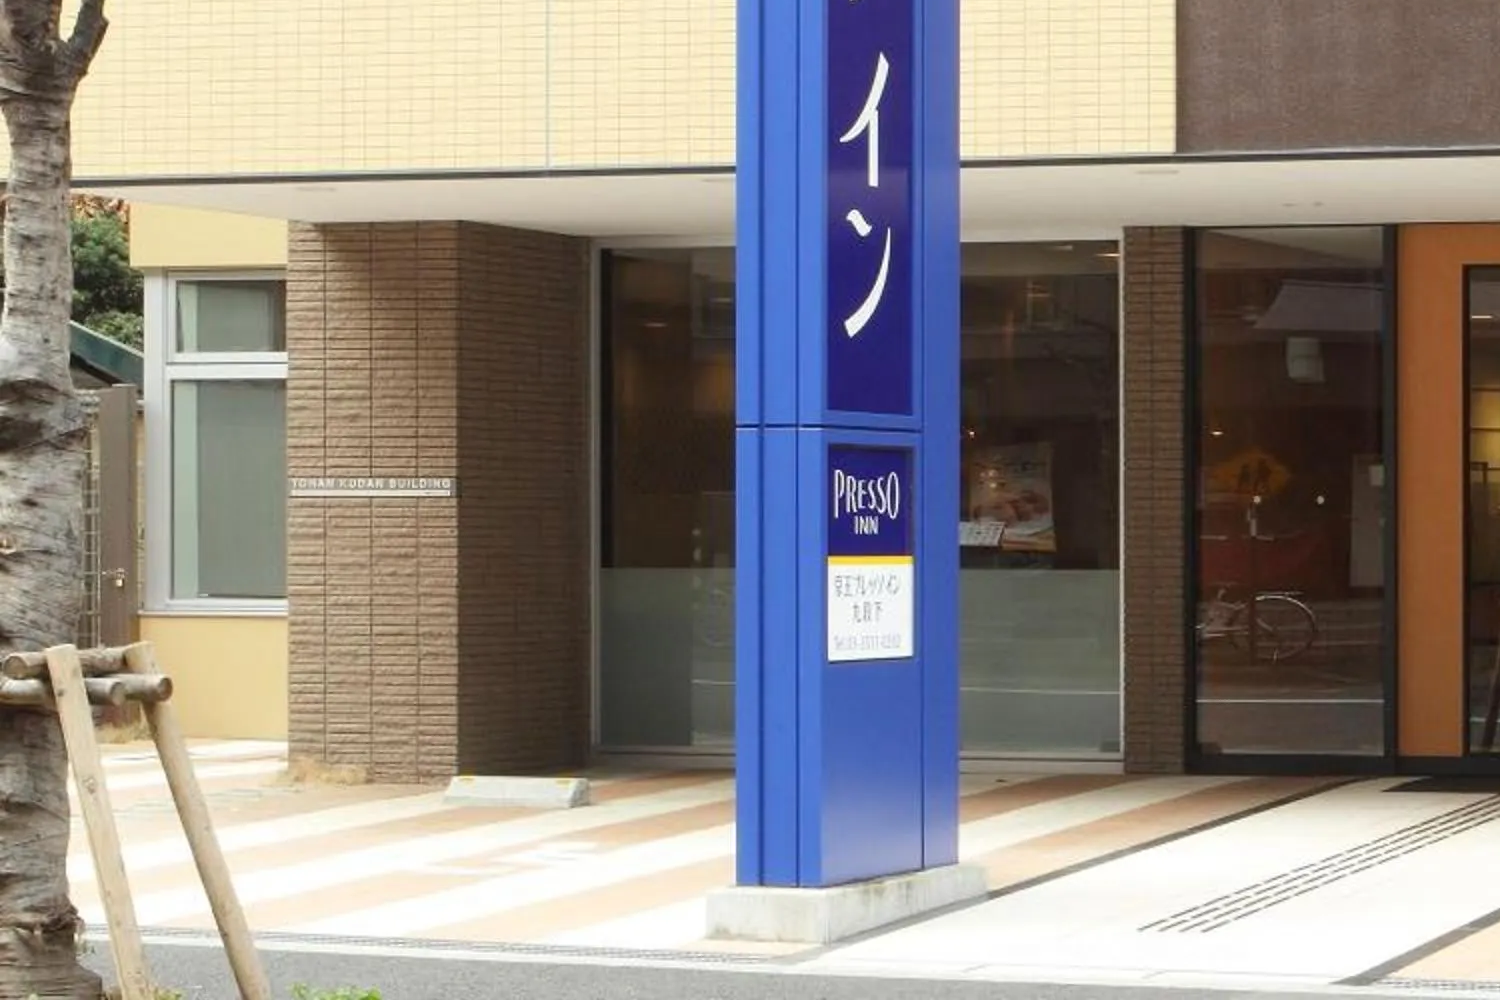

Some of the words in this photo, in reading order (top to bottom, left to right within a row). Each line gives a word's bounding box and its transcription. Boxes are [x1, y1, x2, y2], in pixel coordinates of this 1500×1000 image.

[338, 478, 384, 489] KUDAN
[389, 478, 451, 489] BUILDING
[833, 469, 900, 520] PRESSO
[853, 515, 879, 535] INN
